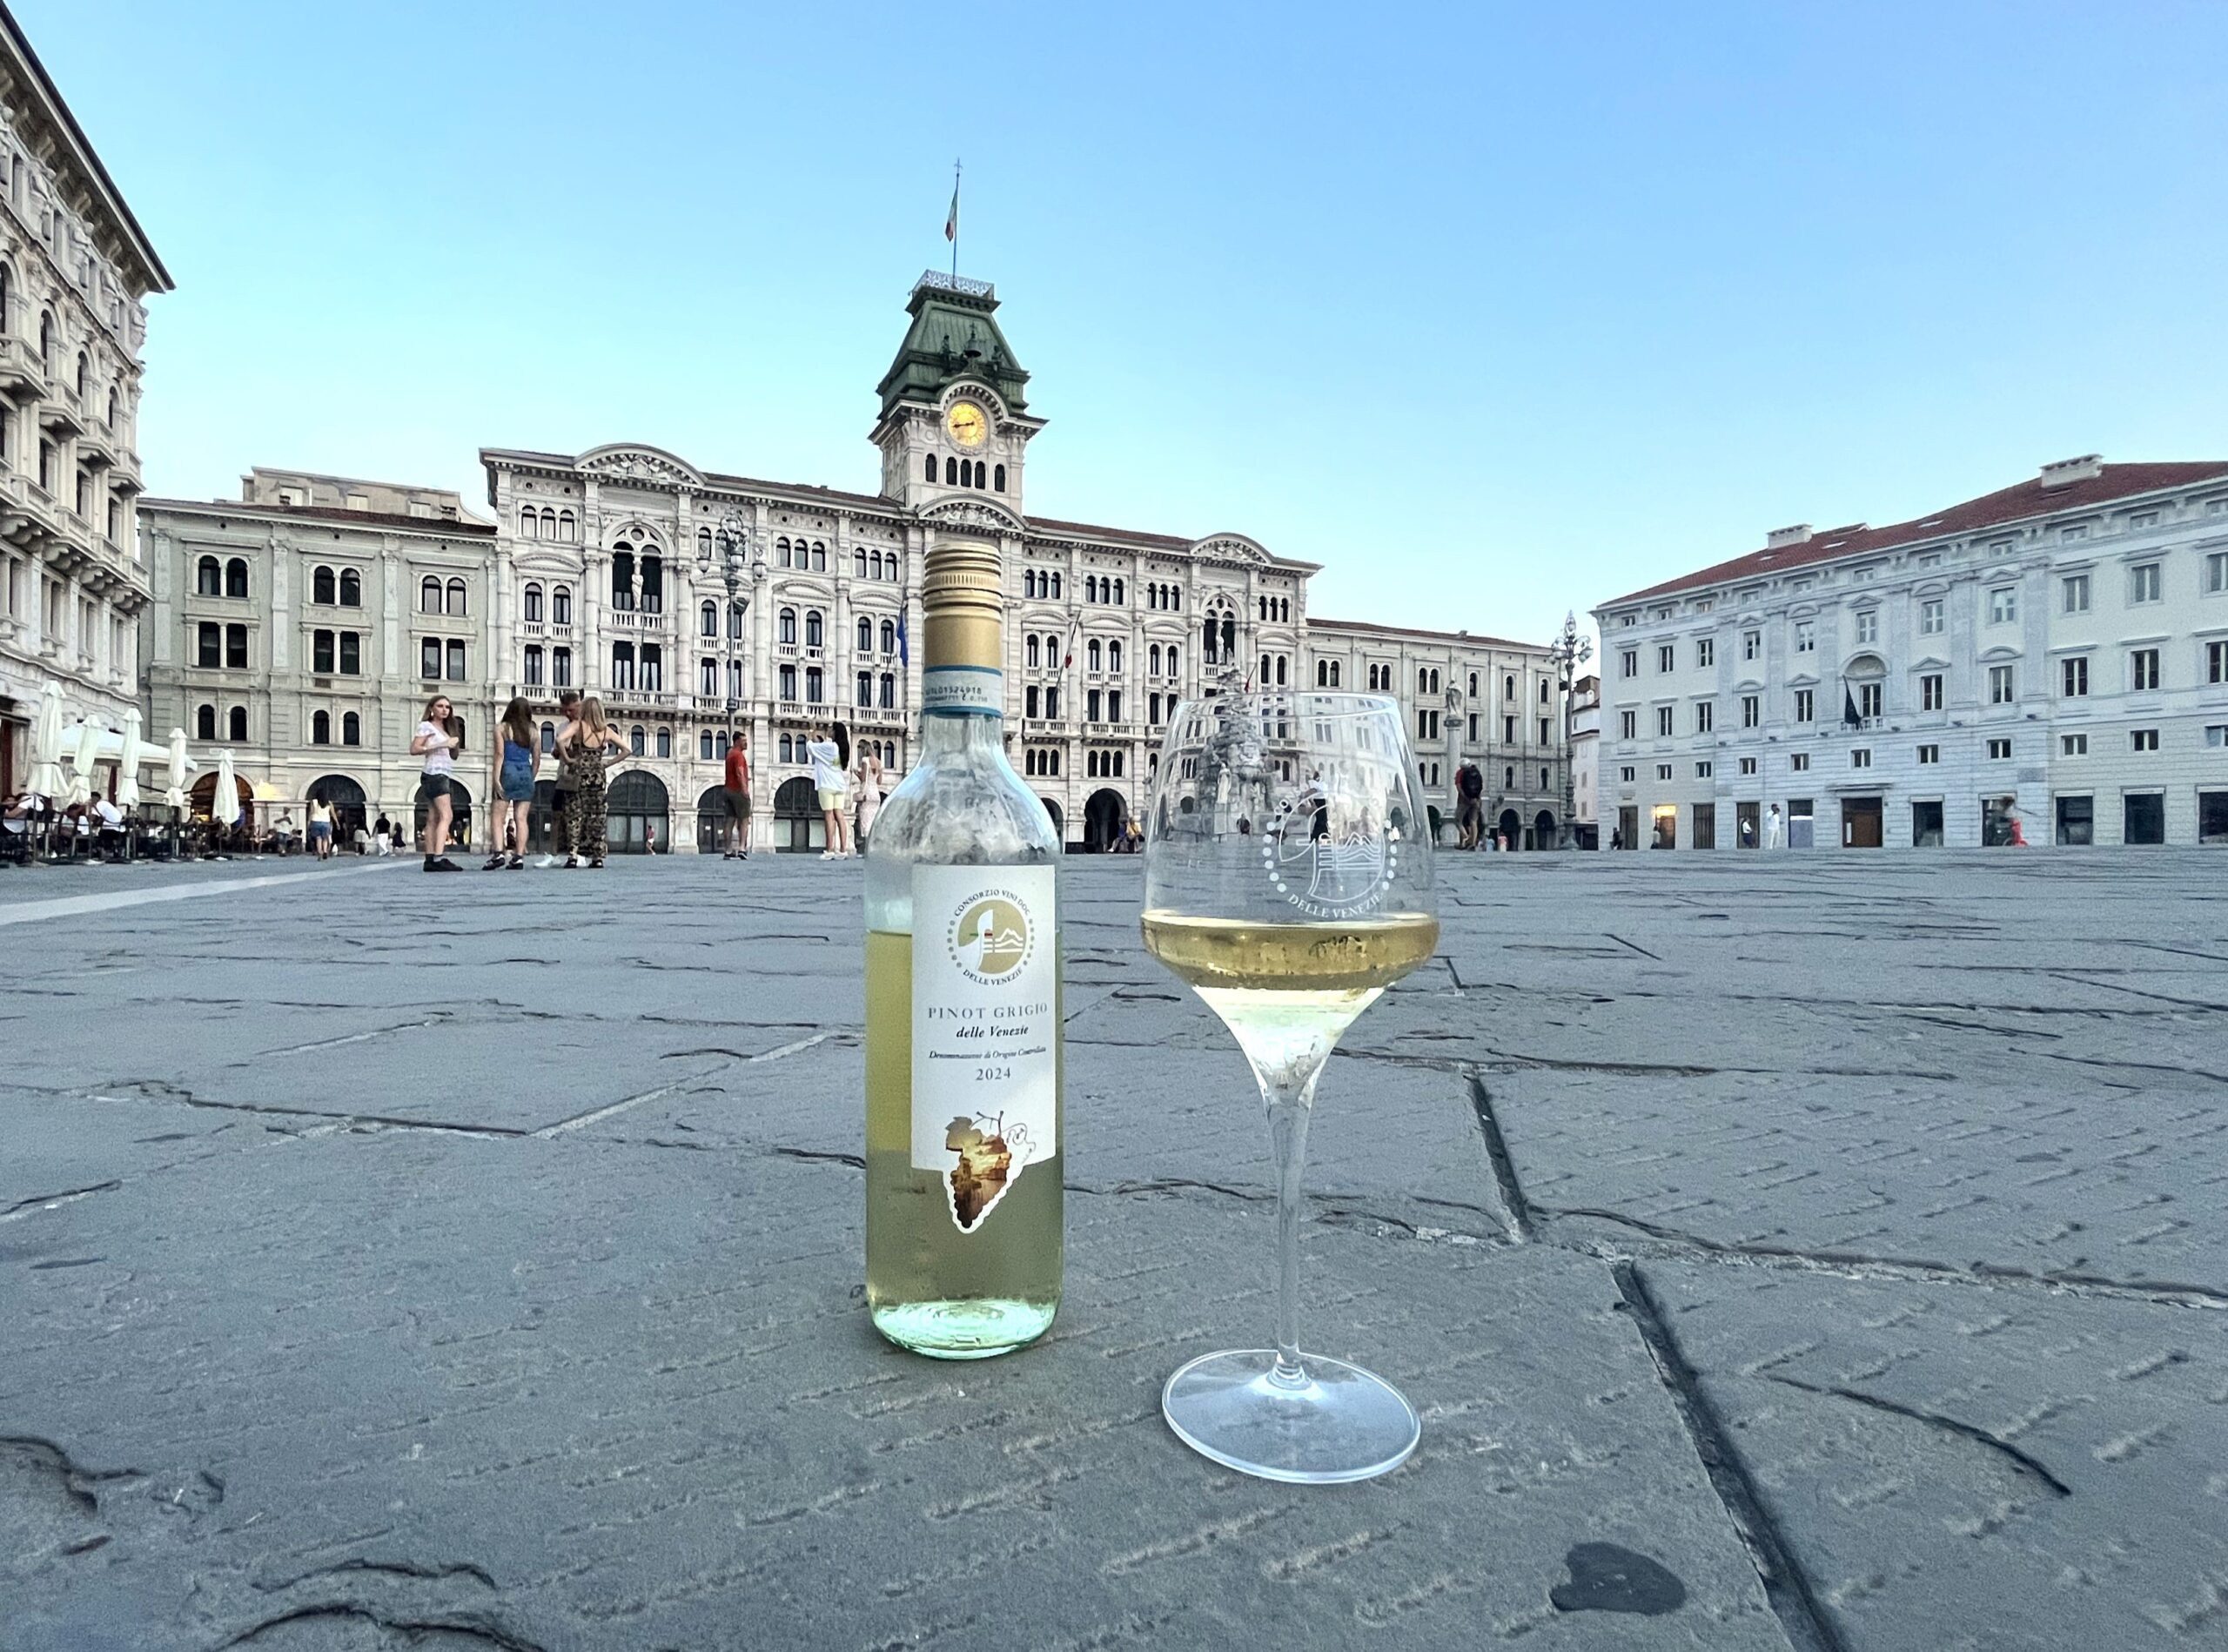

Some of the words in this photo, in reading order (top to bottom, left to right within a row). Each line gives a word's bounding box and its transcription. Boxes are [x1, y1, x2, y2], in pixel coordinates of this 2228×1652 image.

[954, 889, 999, 917] CONSORZIO
[1002, 890, 1017, 902] VINI
[1017, 898, 1030, 916] DOC
[1288, 894, 1329, 918] DELLE
[1332, 890, 1383, 918] VENEZIE
[963, 969, 989, 985] DELLE
[990, 967, 1023, 985] VENEZIE
[929, 1007, 986, 1019] PINOT
[994, 1003, 1048, 1018] GRIGIO
[956, 1026, 984, 1038] delle
[990, 1025, 1029, 1038] Venezie
[976, 1067, 1010, 1080] 2024
